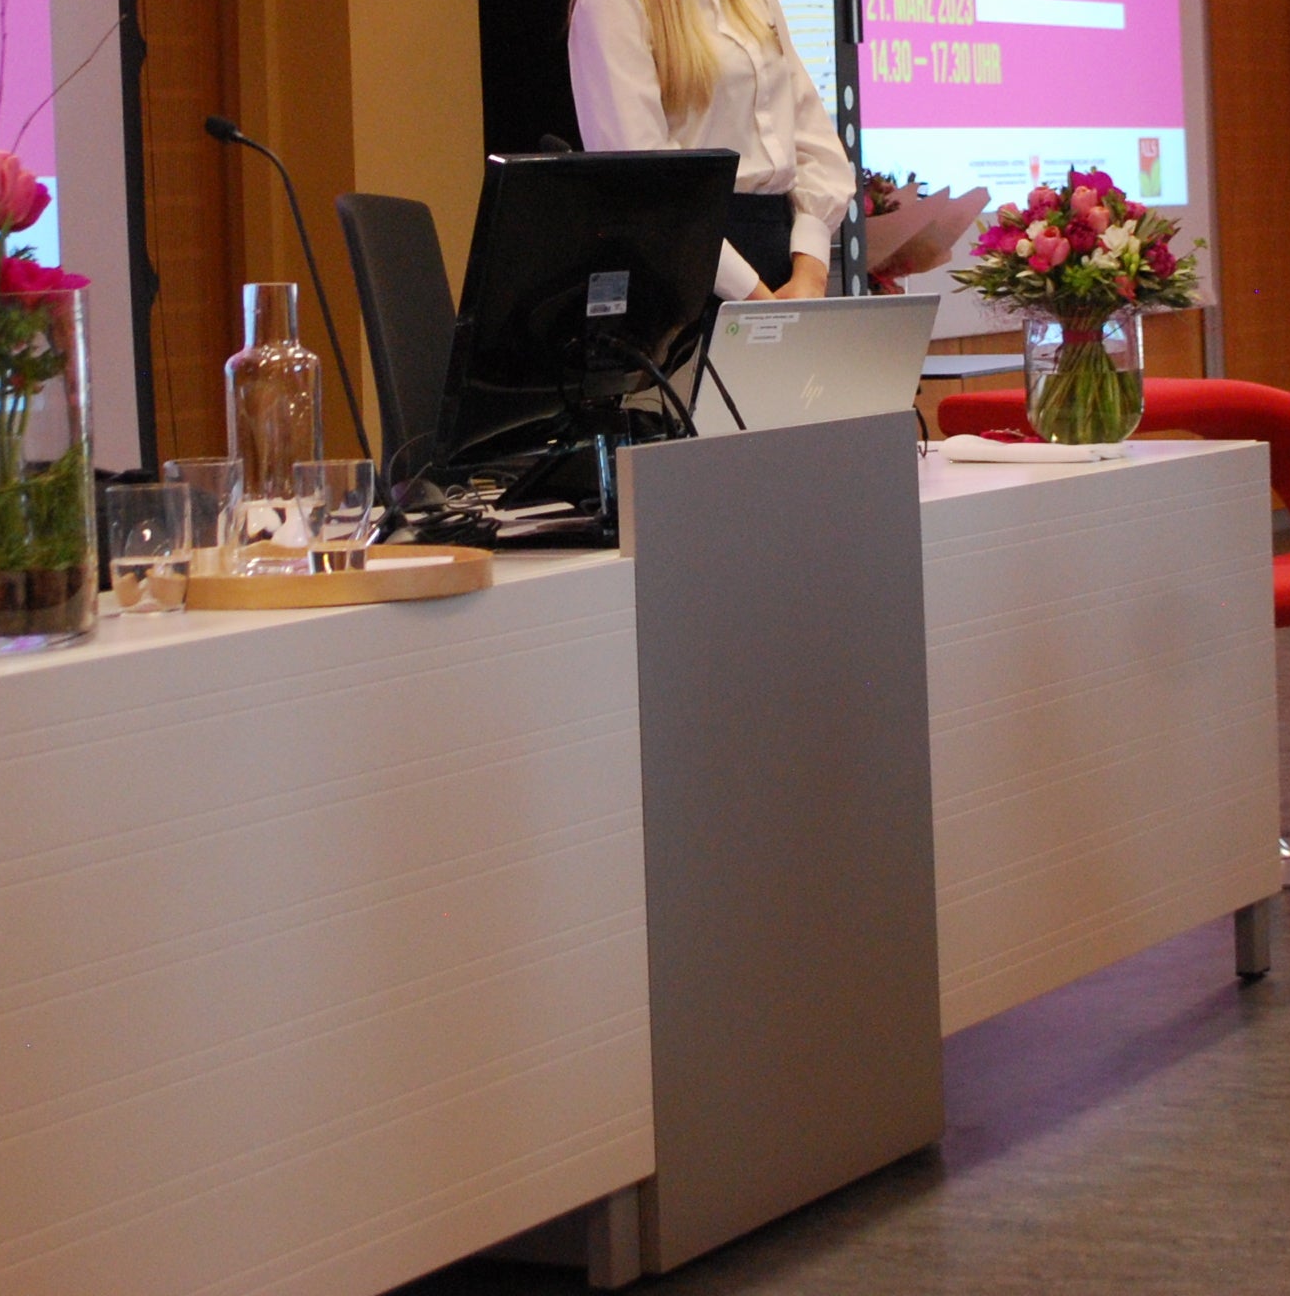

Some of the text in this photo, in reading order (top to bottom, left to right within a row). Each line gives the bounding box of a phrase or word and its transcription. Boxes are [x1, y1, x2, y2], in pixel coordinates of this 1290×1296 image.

[870, 38, 913, 84] 14.30
[931, 40, 972, 85] 17.30
[973, 42, 1003, 86] UHR
